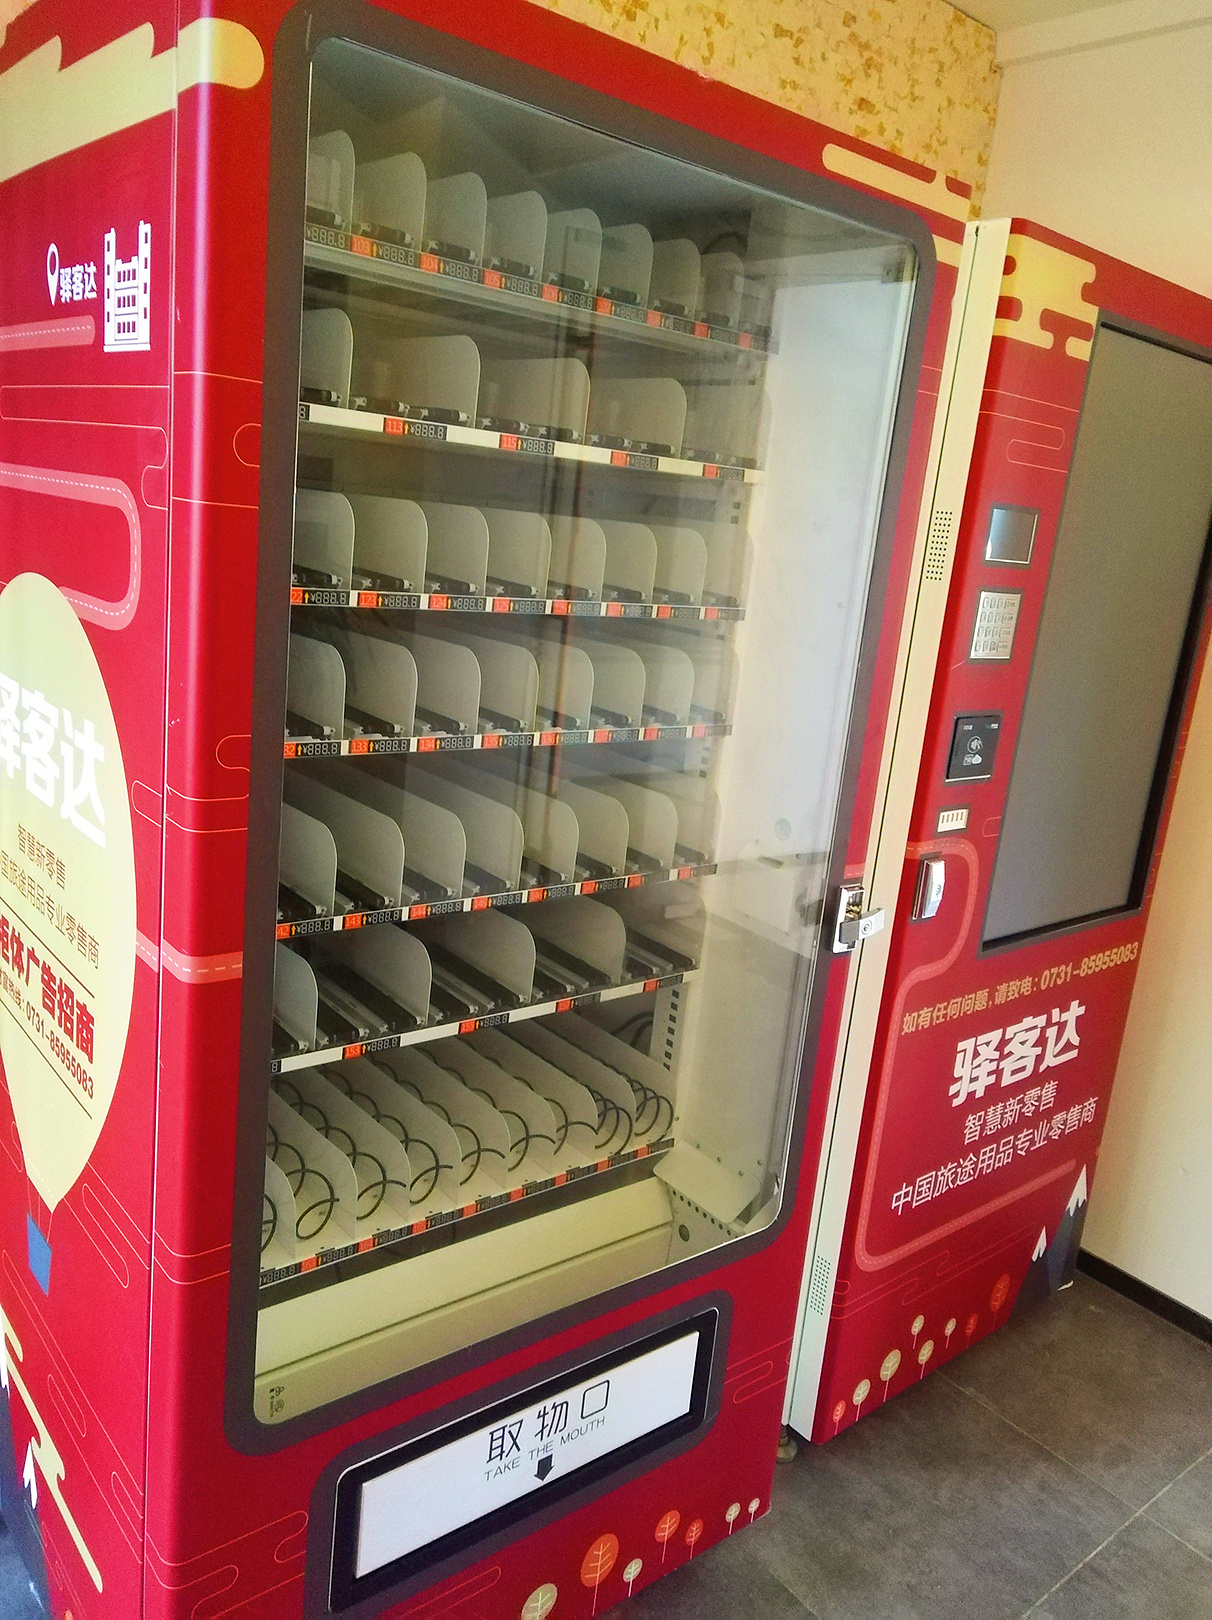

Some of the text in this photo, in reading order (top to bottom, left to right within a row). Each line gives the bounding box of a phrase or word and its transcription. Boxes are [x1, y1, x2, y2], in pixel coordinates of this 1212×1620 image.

[59, 261, 97, 303] 驿客达
[387, 418, 404, 433] 113
[360, 594, 378, 607] 123
[431, 596, 448, 609] 124
[352, 741, 369, 754] 133
[420, 739, 436, 753] 134
[346, 915, 363, 930] 143
[346, 1043, 363, 1059] 153
[949, 1000, 1086, 1108] 驿客达
[964, 1080, 1059, 1145] 智慧新零售
[890, 1096, 1099, 1216] 中国旅途用品专业零售商
[487, 1379, 611, 1465] 取物口
[484, 1416, 606, 1482] TAKE THE MOUTH
